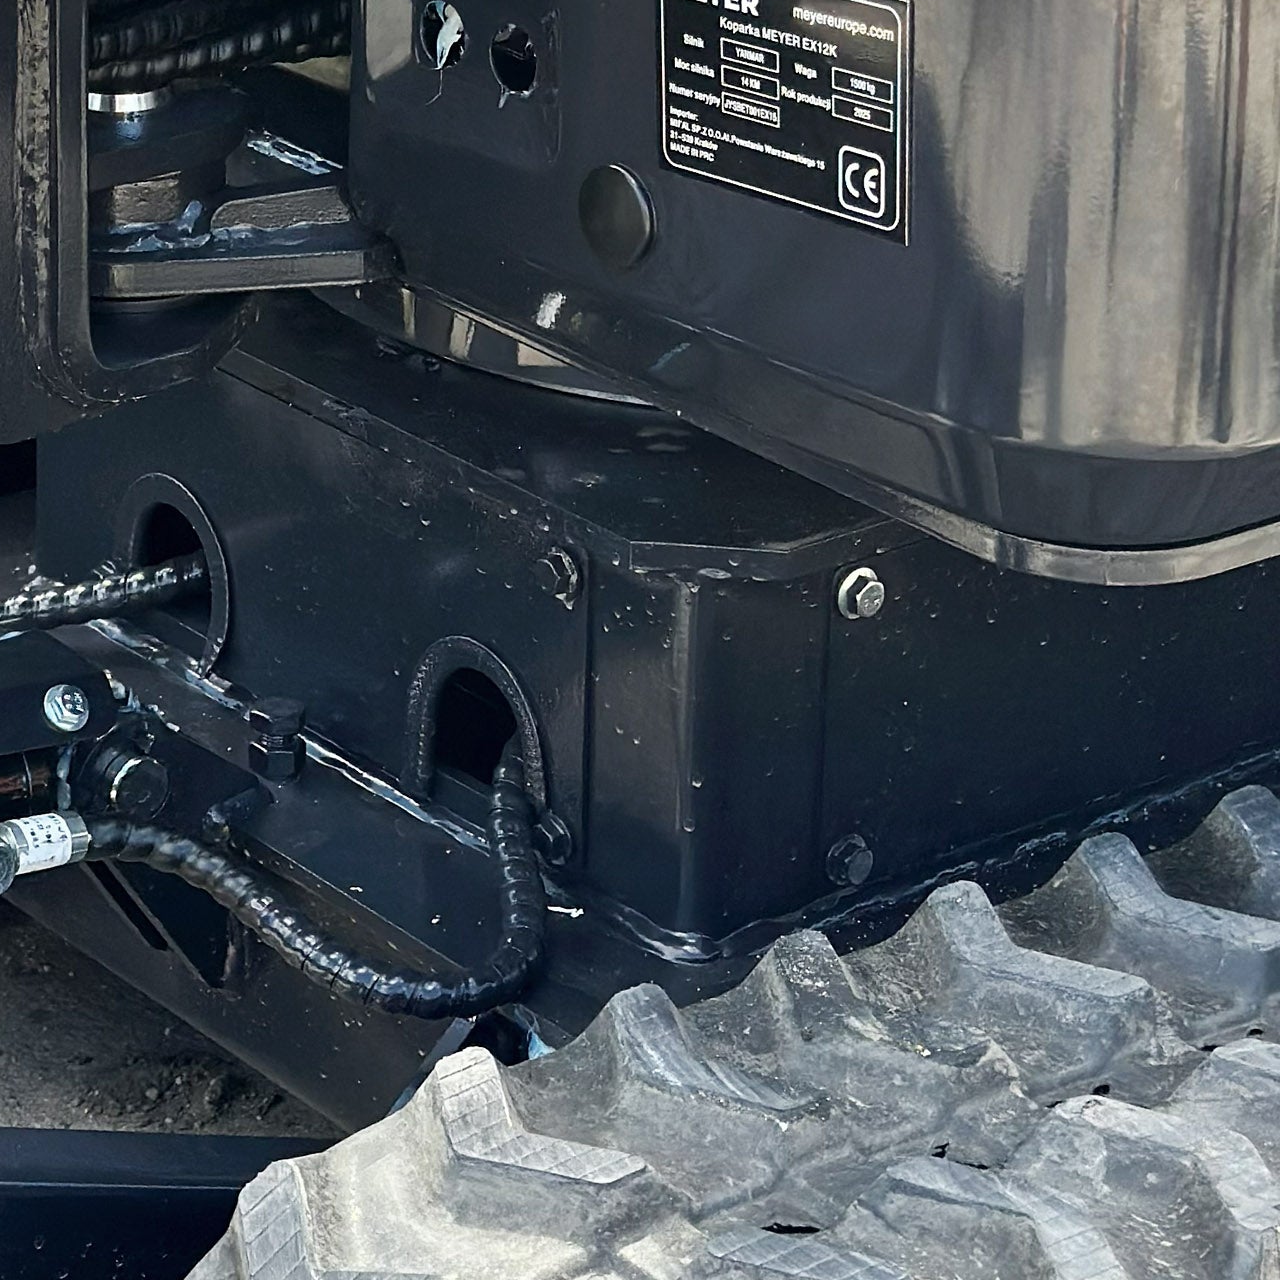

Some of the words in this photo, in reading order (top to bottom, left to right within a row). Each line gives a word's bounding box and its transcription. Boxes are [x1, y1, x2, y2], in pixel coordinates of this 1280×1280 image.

[792, 6, 895, 42] meyereurope.com
[720, 16, 760, 37] Koparka
[762, 26, 801, 48] MEYER
[802, 37, 838, 58] EX12K
[735, 46, 765, 64] YANMAR
[794, 62, 818, 80] Waga
[740, 76, 749, 86] 14
[781, 85, 797, 100] Rok
[669, 141, 691, 156] MADE
